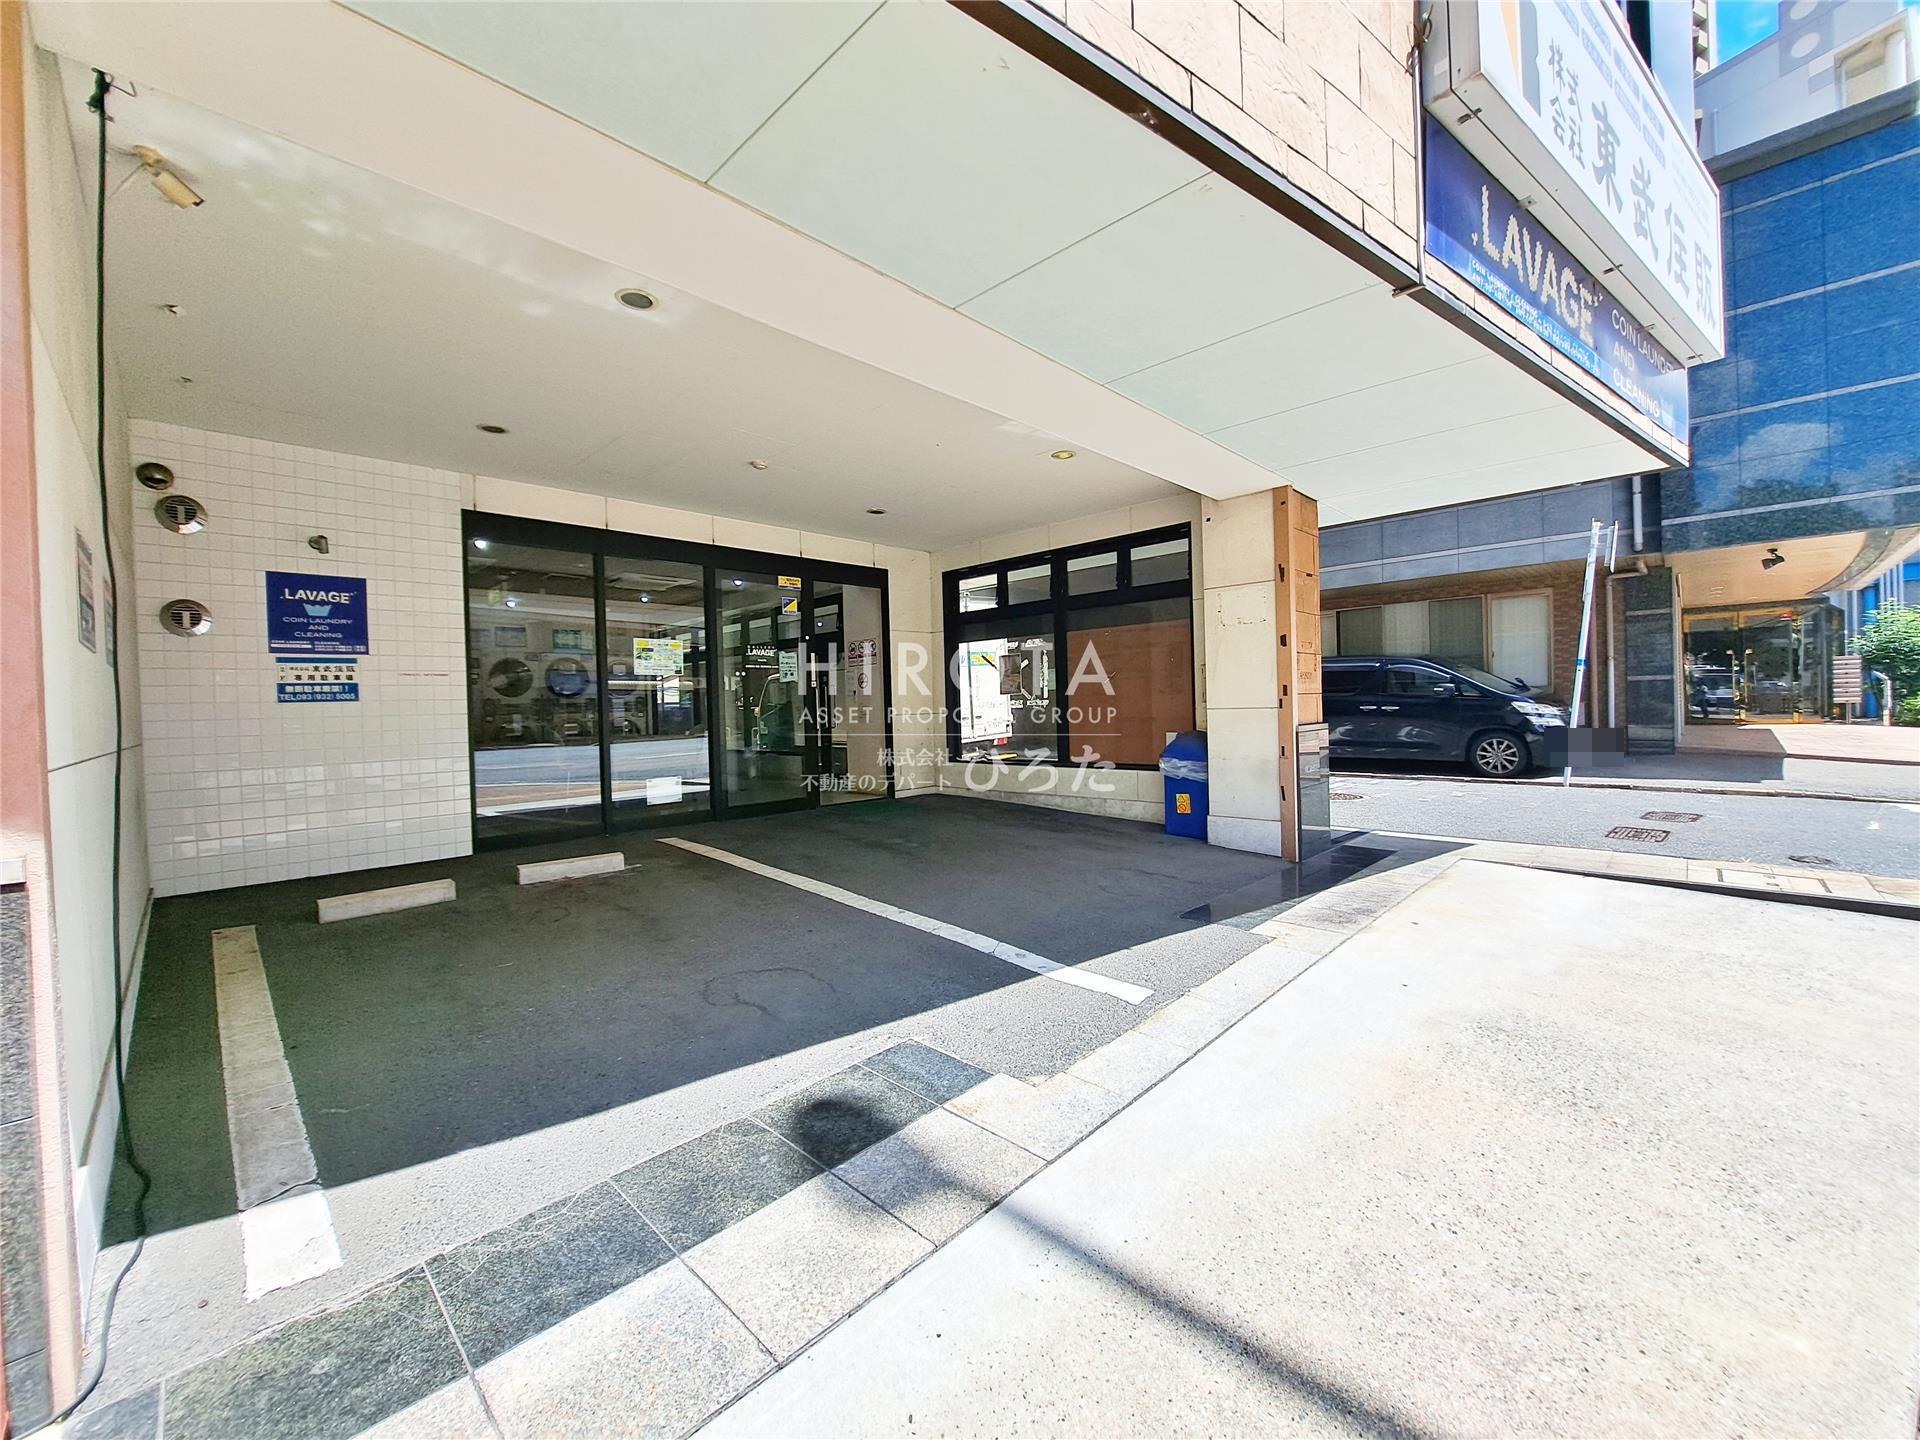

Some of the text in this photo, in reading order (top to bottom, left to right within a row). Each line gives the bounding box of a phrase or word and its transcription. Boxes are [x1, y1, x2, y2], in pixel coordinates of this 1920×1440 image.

[1591, 100, 1716, 328] 東武住販
[1481, 185, 1595, 348] LAVAGE
[1611, 309, 1636, 346] COIN
[1613, 341, 1635, 372] AND
[1613, 368, 1660, 417] CLEANING
[284, 588, 350, 604] LAVAGE
[309, 617, 353, 625] LAUNDRY
